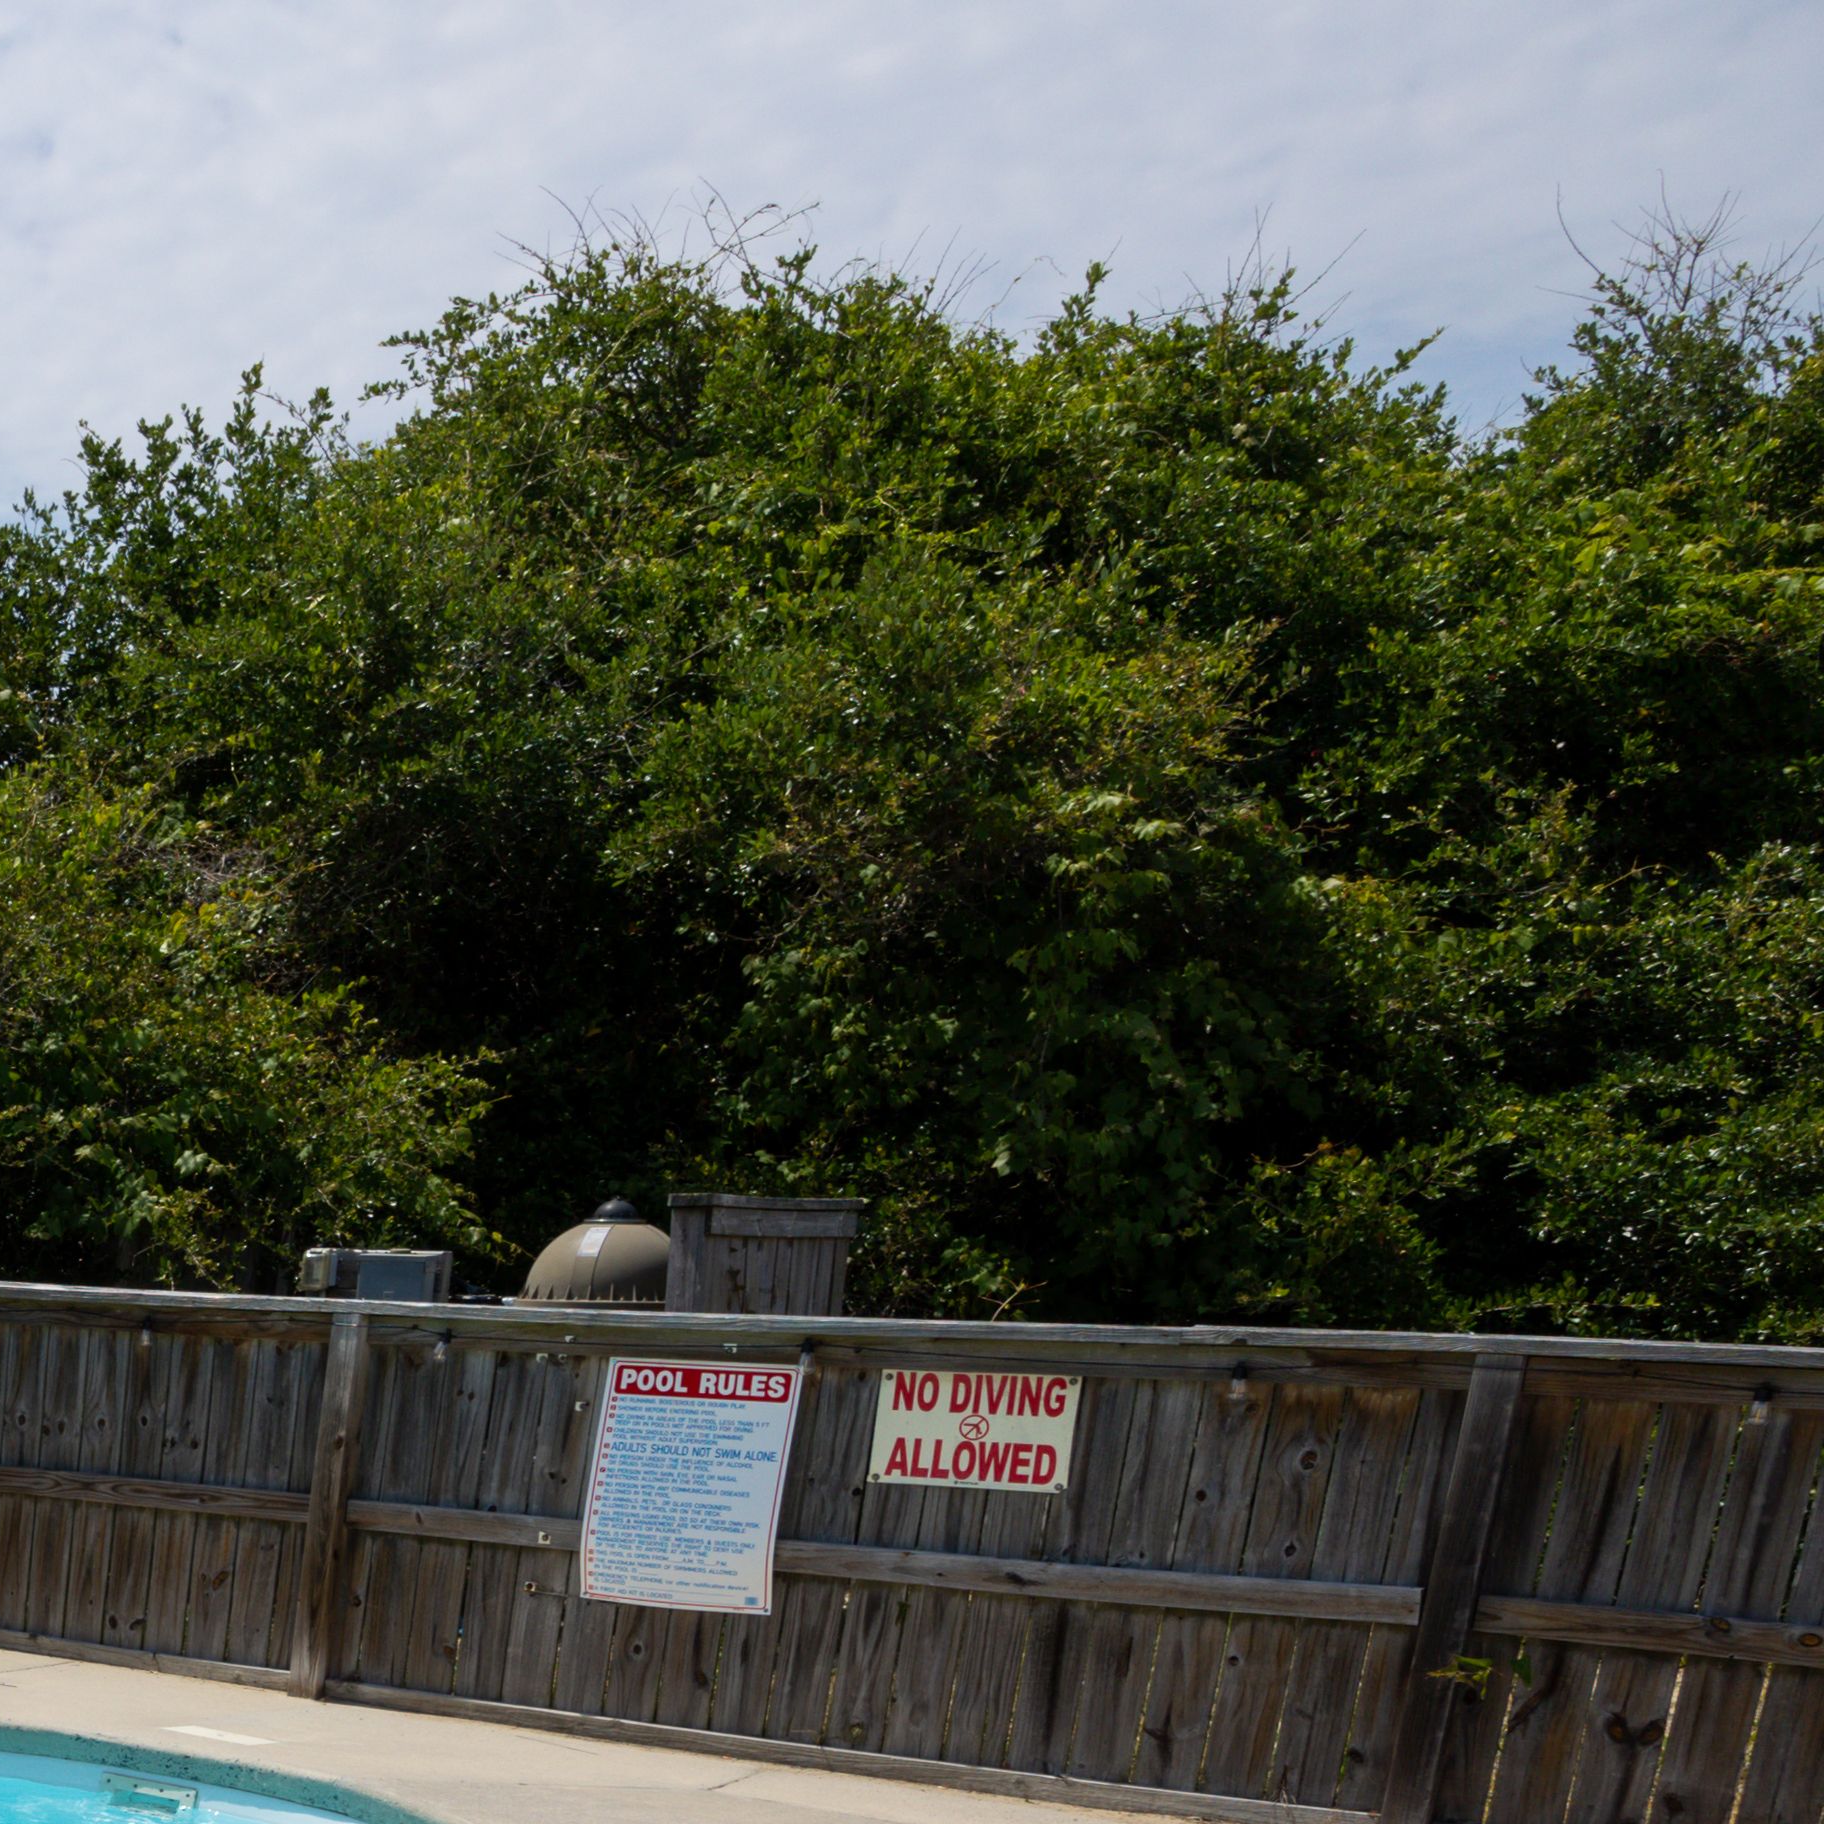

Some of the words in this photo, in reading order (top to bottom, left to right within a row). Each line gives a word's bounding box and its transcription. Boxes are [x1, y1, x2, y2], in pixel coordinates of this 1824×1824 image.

[620, 1368, 688, 1393] POOL
[699, 1372, 786, 1398] RULES
[892, 1372, 940, 1412] NO
[949, 1374, 1068, 1418] DIVING
[612, 1442, 647, 1453] ADULTS
[651, 1444, 689, 1456] SHOULD
[693, 1447, 711, 1457] NOT
[715, 1448, 741, 1458] SWIM
[884, 1437, 1057, 1486] ALLOWED
